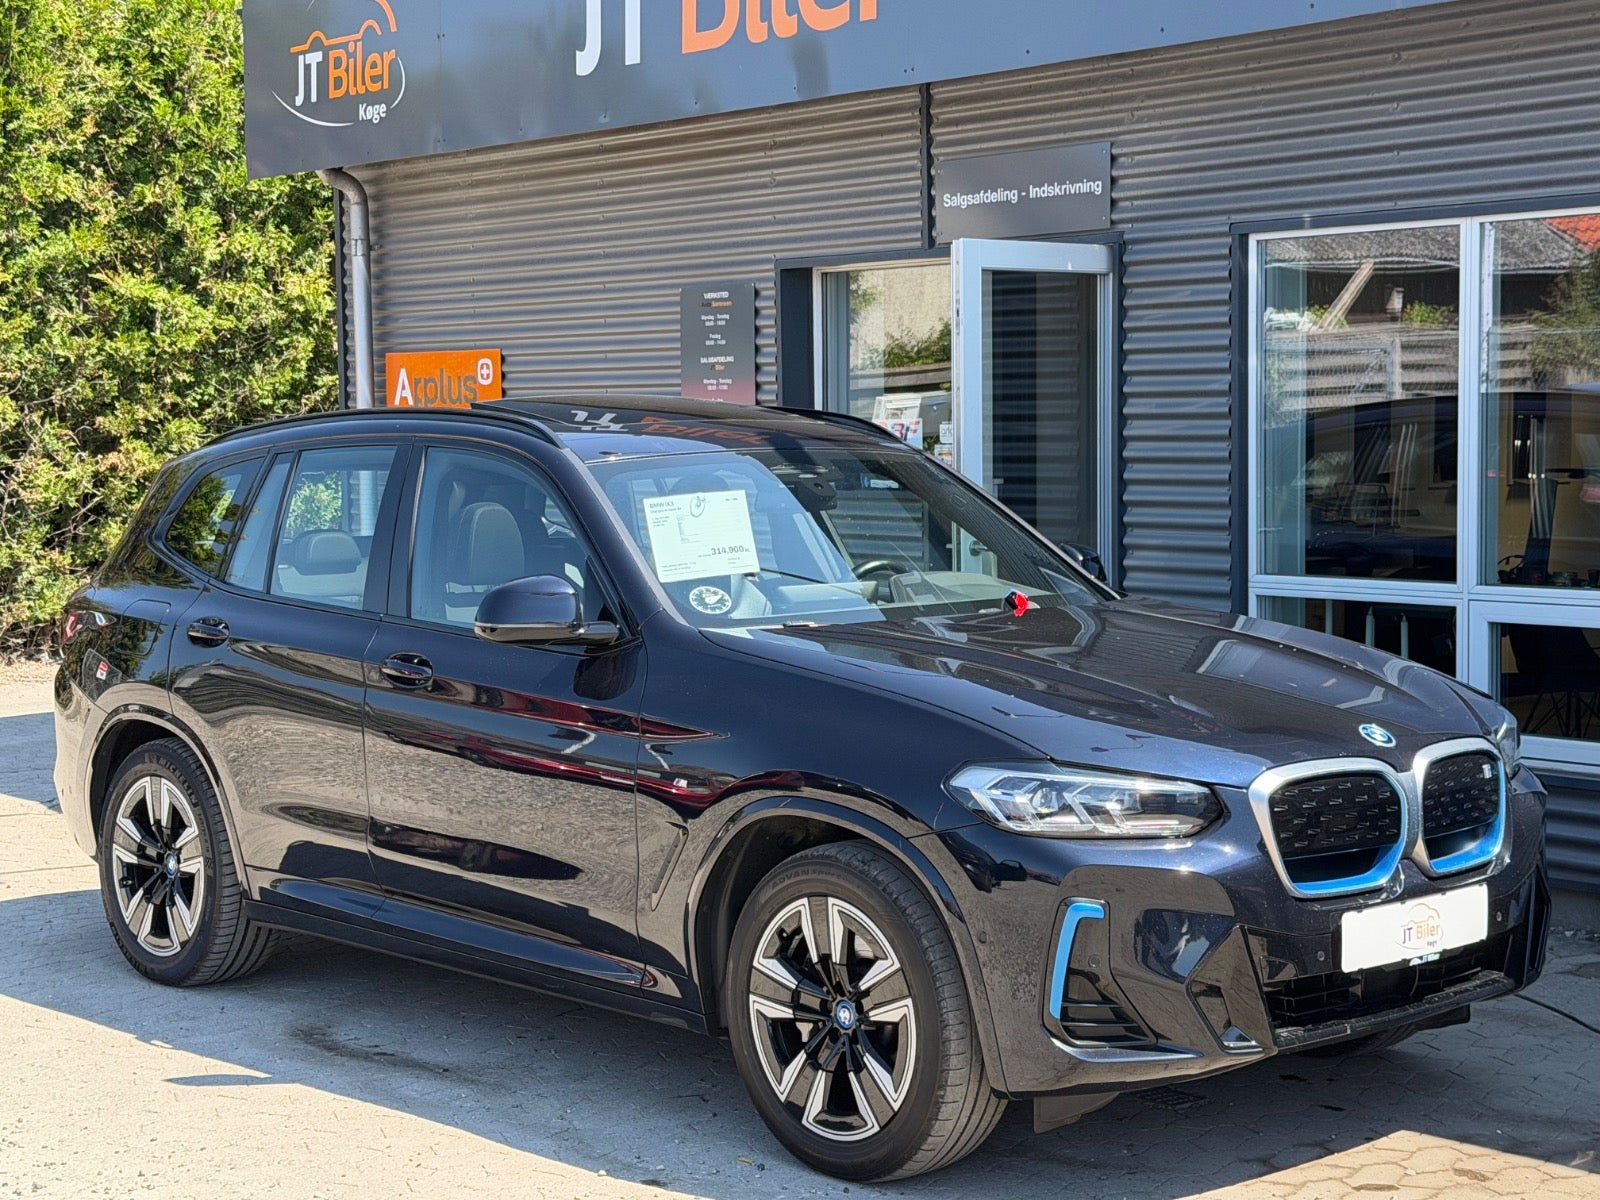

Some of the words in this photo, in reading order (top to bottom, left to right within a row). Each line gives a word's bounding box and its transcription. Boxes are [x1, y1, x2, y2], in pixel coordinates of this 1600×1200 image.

[295, 51, 323, 107] JT
[328, 41, 396, 99] Biler
[358, 103, 387, 124] Køge
[943, 188, 1018, 209] Salgsafdeling
[1029, 179, 1102, 199] Indskrivning
[711, 545, 744, 556] 314.900
[772, 868, 809, 890] ADVAN
[1402, 927, 1413, 944] JT
[1416, 924, 1440, 940] Biler
